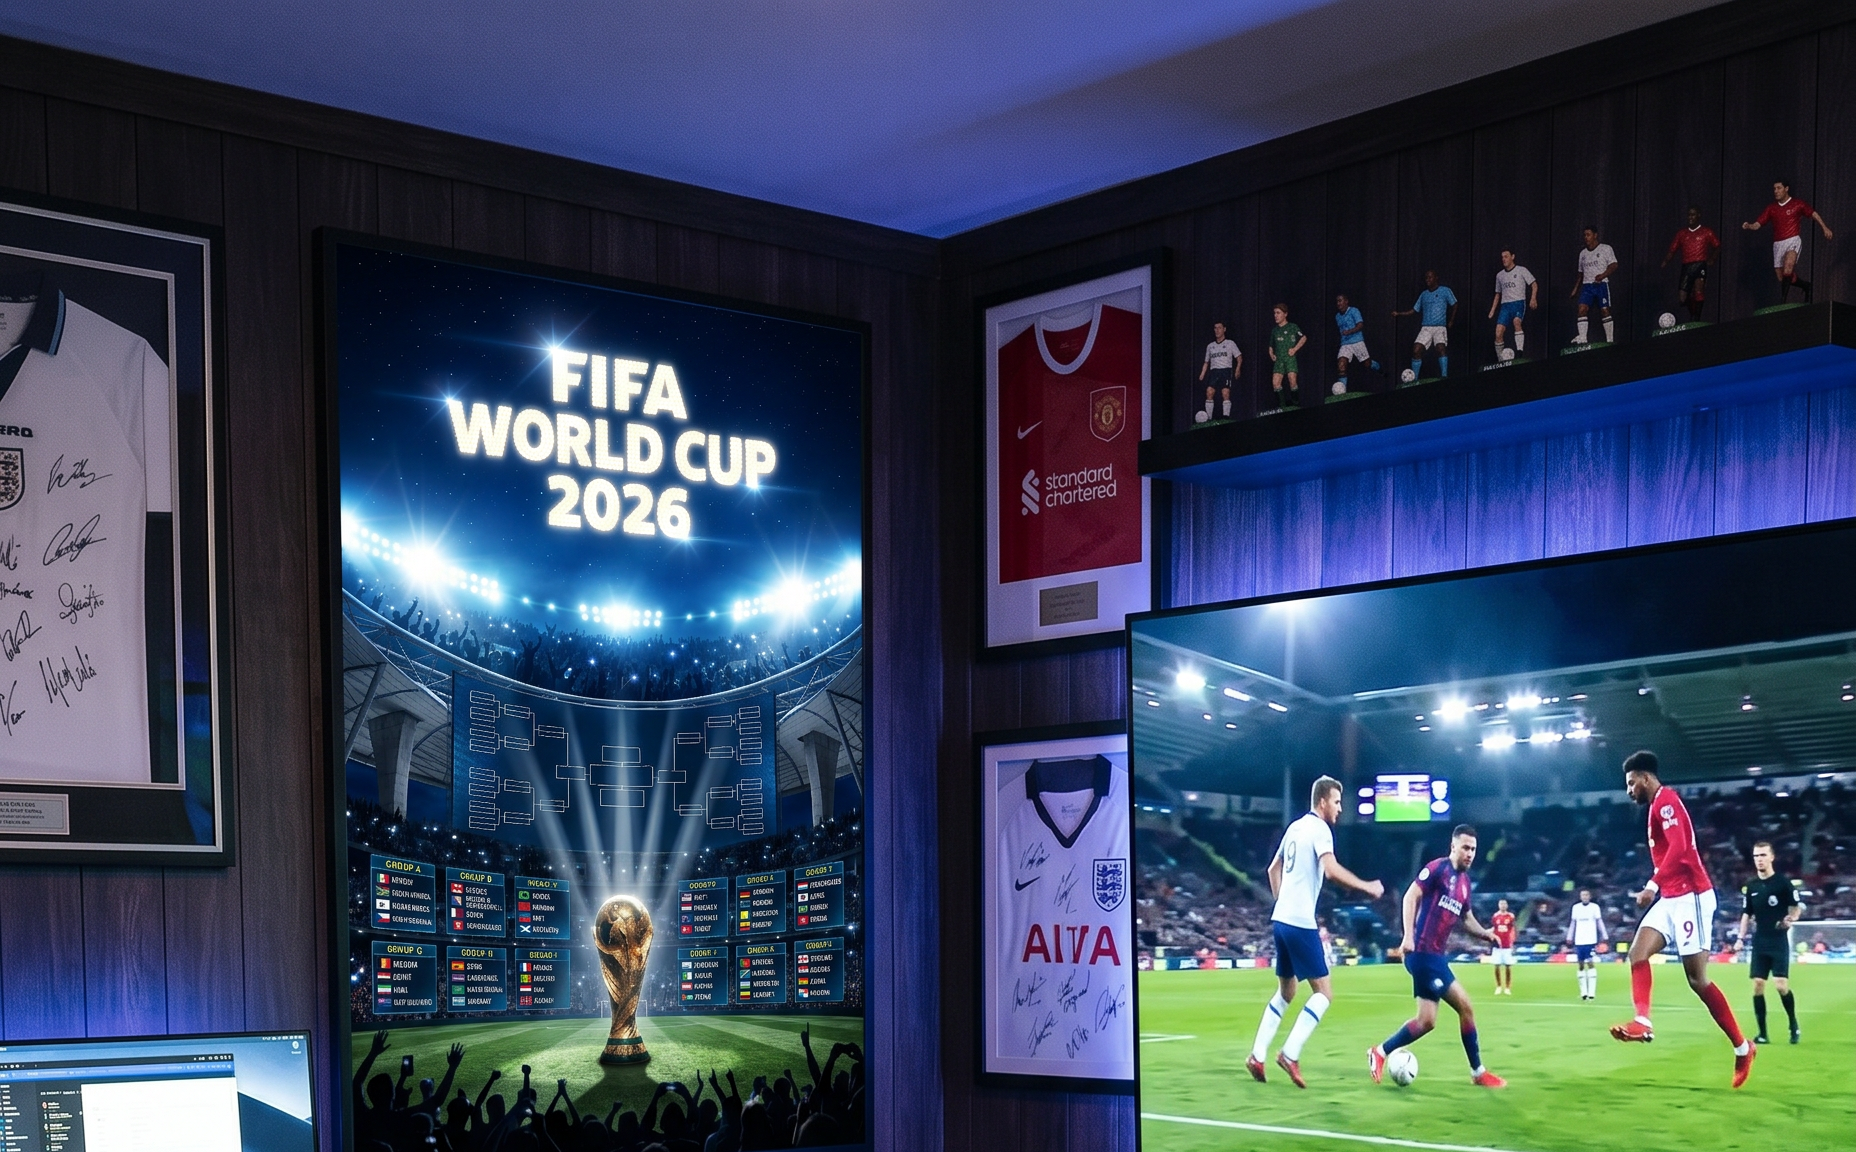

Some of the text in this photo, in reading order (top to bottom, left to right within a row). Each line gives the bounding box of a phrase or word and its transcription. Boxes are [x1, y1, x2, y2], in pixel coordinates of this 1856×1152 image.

[551, 349, 688, 419] FIFA
[447, 399, 776, 488] WORLD CUP
[1045, 463, 1112, 490] standard
[547, 474, 691, 539] 2026
[1045, 480, 1117, 508] chartered
[1285, 841, 1297, 873] 9
[1683, 921, 1694, 939] 9
